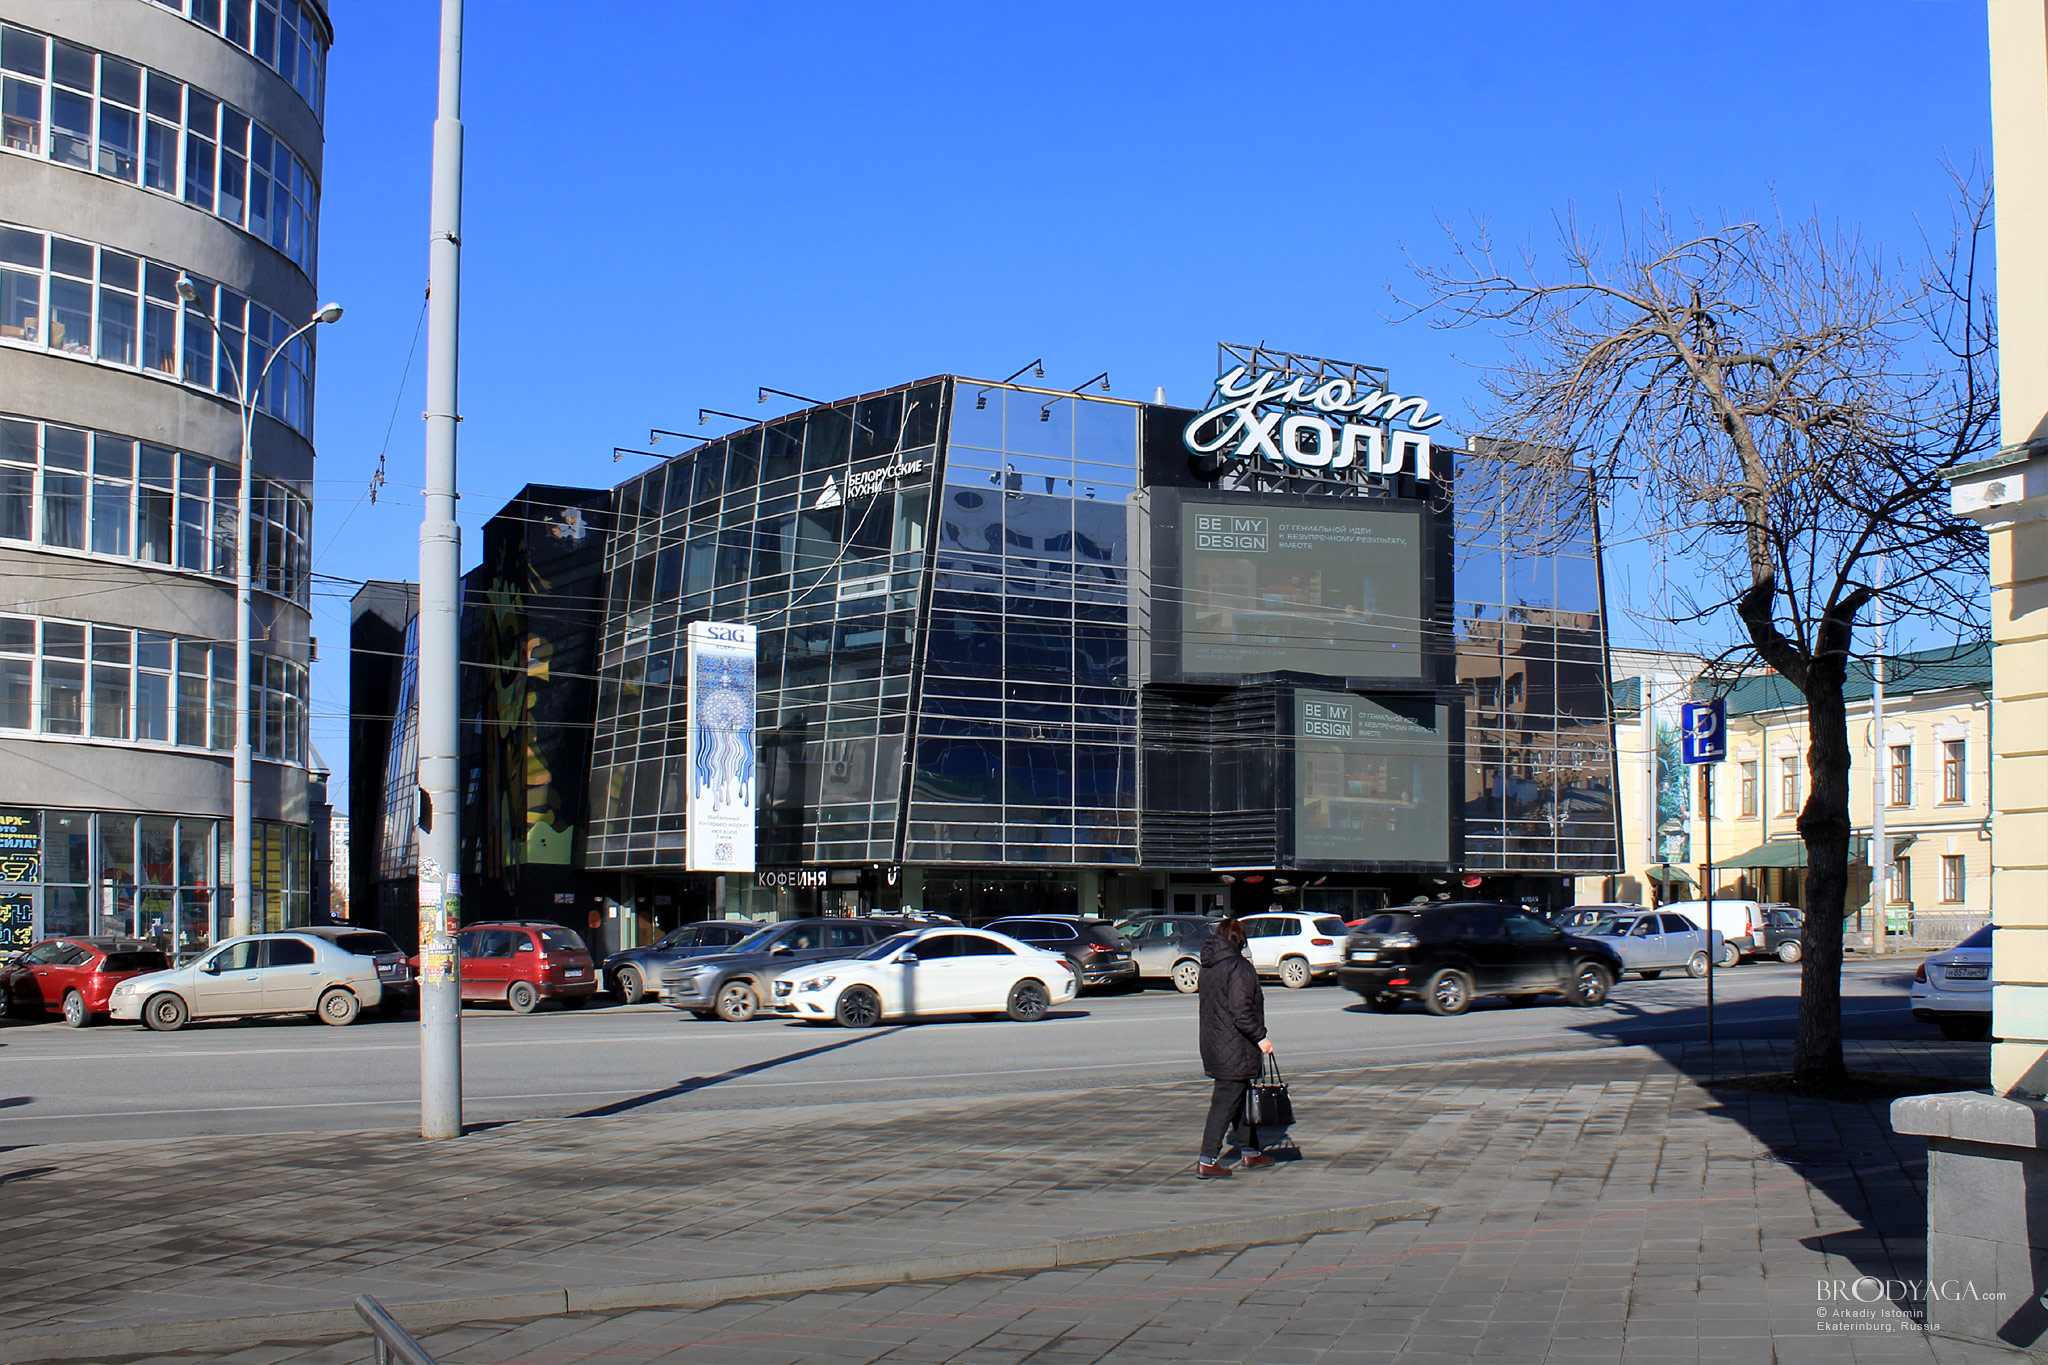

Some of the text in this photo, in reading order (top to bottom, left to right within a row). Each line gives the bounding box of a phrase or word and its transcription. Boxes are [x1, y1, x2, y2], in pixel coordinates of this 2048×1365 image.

[1231, 406, 1431, 482] ХОЛЛ
[848, 459, 923, 486] БЕЛОРУССКИЕ
[846, 481, 883, 499] КУХНИ
[1199, 518, 1262, 532] BE MY
[1292, 524, 1347, 534] ГЕНИАЛЬНОЙ
[1199, 534, 1265, 549] DESIGN
[1287, 534, 1353, 543] БЕЗУПРЕЧНОМУ
[1305, 704, 1348, 719] BE MY
[1305, 721, 1350, 736] DESIGN
[758, 867, 827, 886] КОФЕЙНЯ
